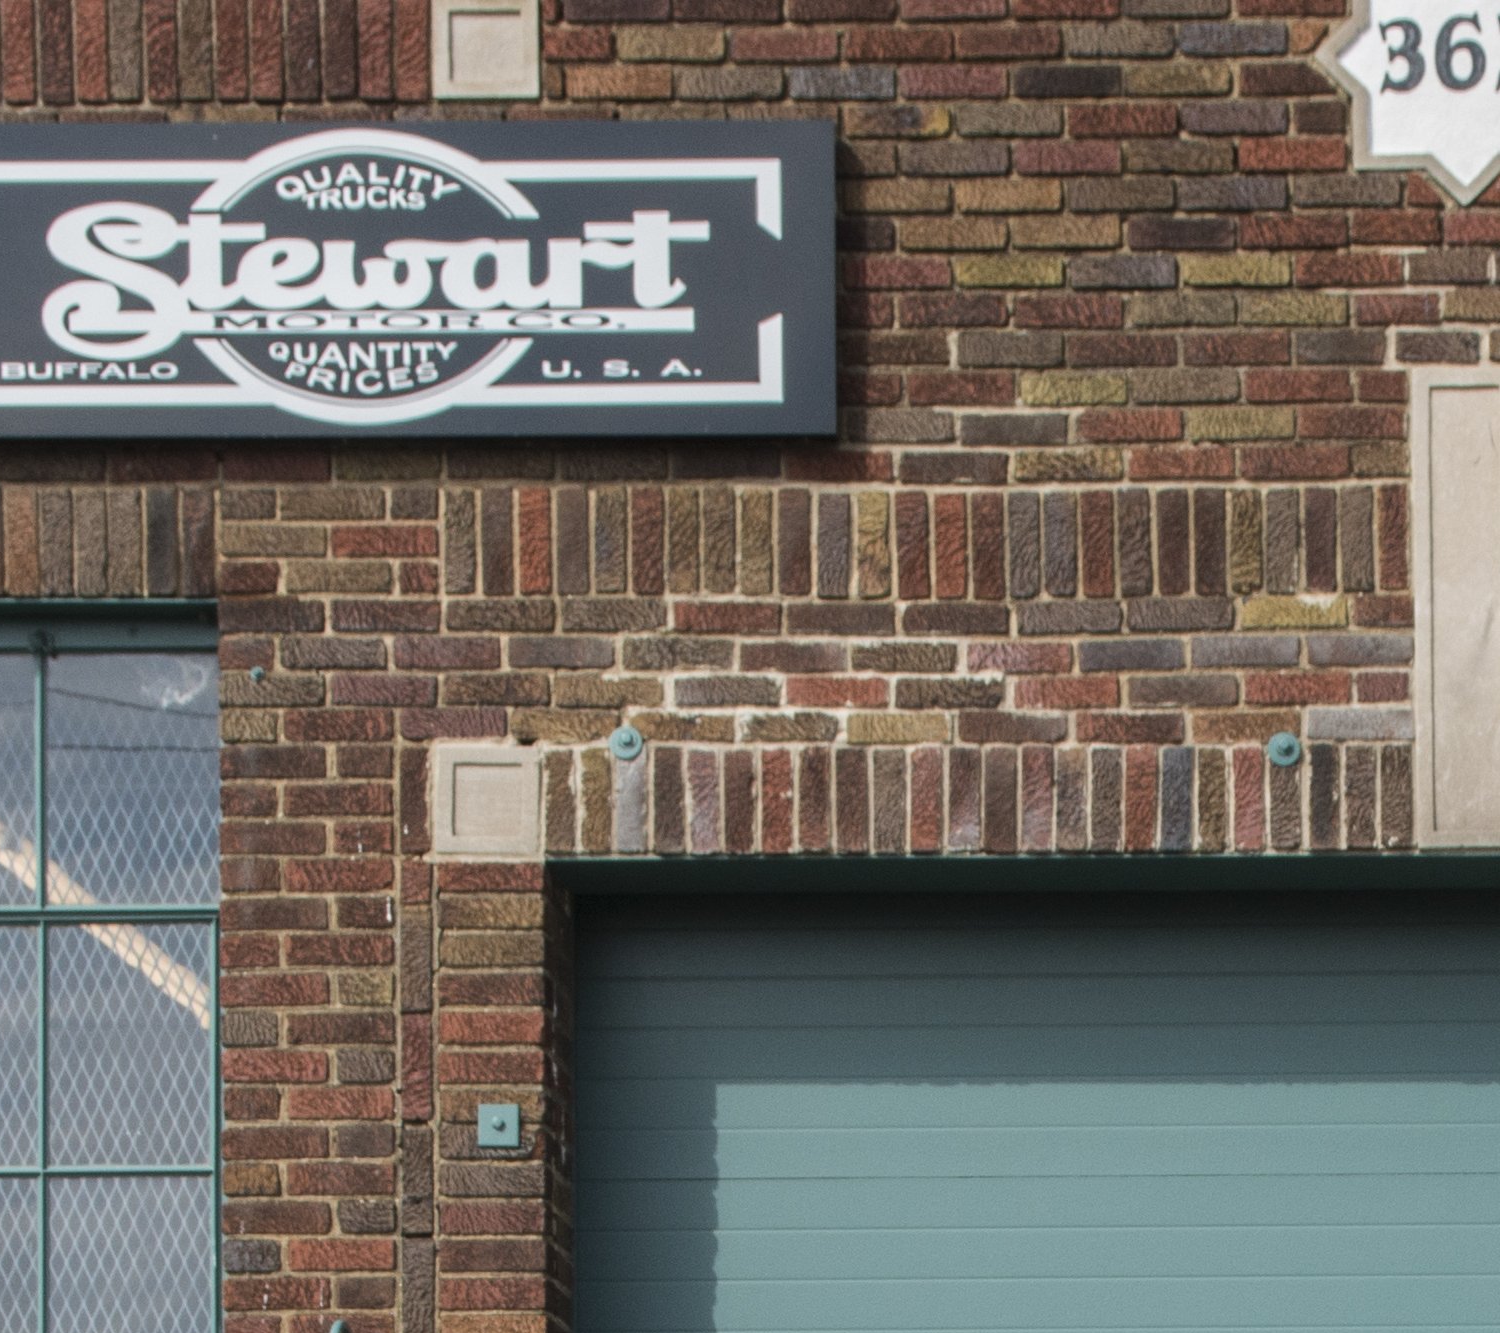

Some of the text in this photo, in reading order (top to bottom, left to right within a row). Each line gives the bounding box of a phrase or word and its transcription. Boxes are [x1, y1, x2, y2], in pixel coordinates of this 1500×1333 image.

[275, 162, 462, 201] QUALITY
[302, 185, 427, 211] TRUCKS
[41, 201, 711, 361] Stewart
[213, 313, 626, 330] MOTOR CO.
[268, 341, 458, 370] QUANTITY
[0, 361, 180, 381] BUFFALO
[285, 361, 440, 395] PRICES
